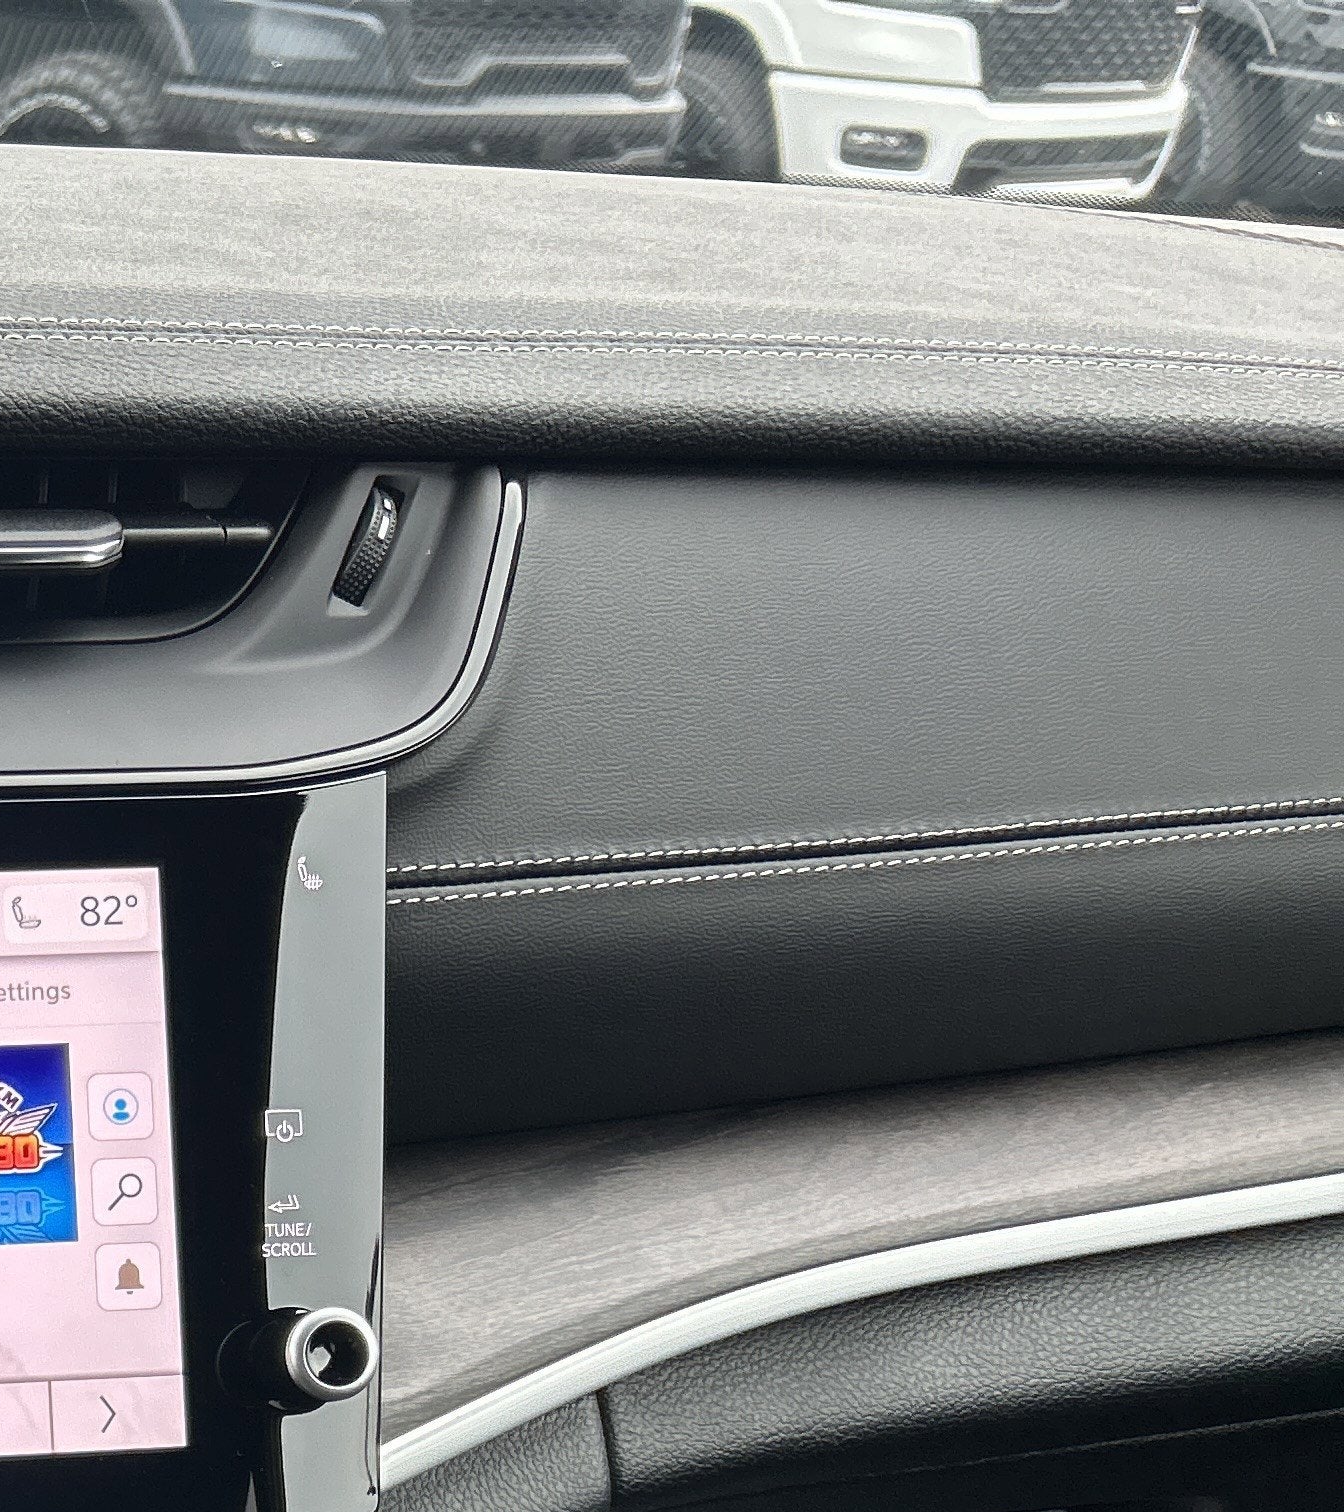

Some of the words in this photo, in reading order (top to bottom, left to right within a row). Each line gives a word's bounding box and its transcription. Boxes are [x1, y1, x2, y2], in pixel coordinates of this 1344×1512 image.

[80, 894, 139, 928] 82°
[264, 1222, 313, 1238] TUNE/
[262, 1243, 317, 1258] SCROLL
